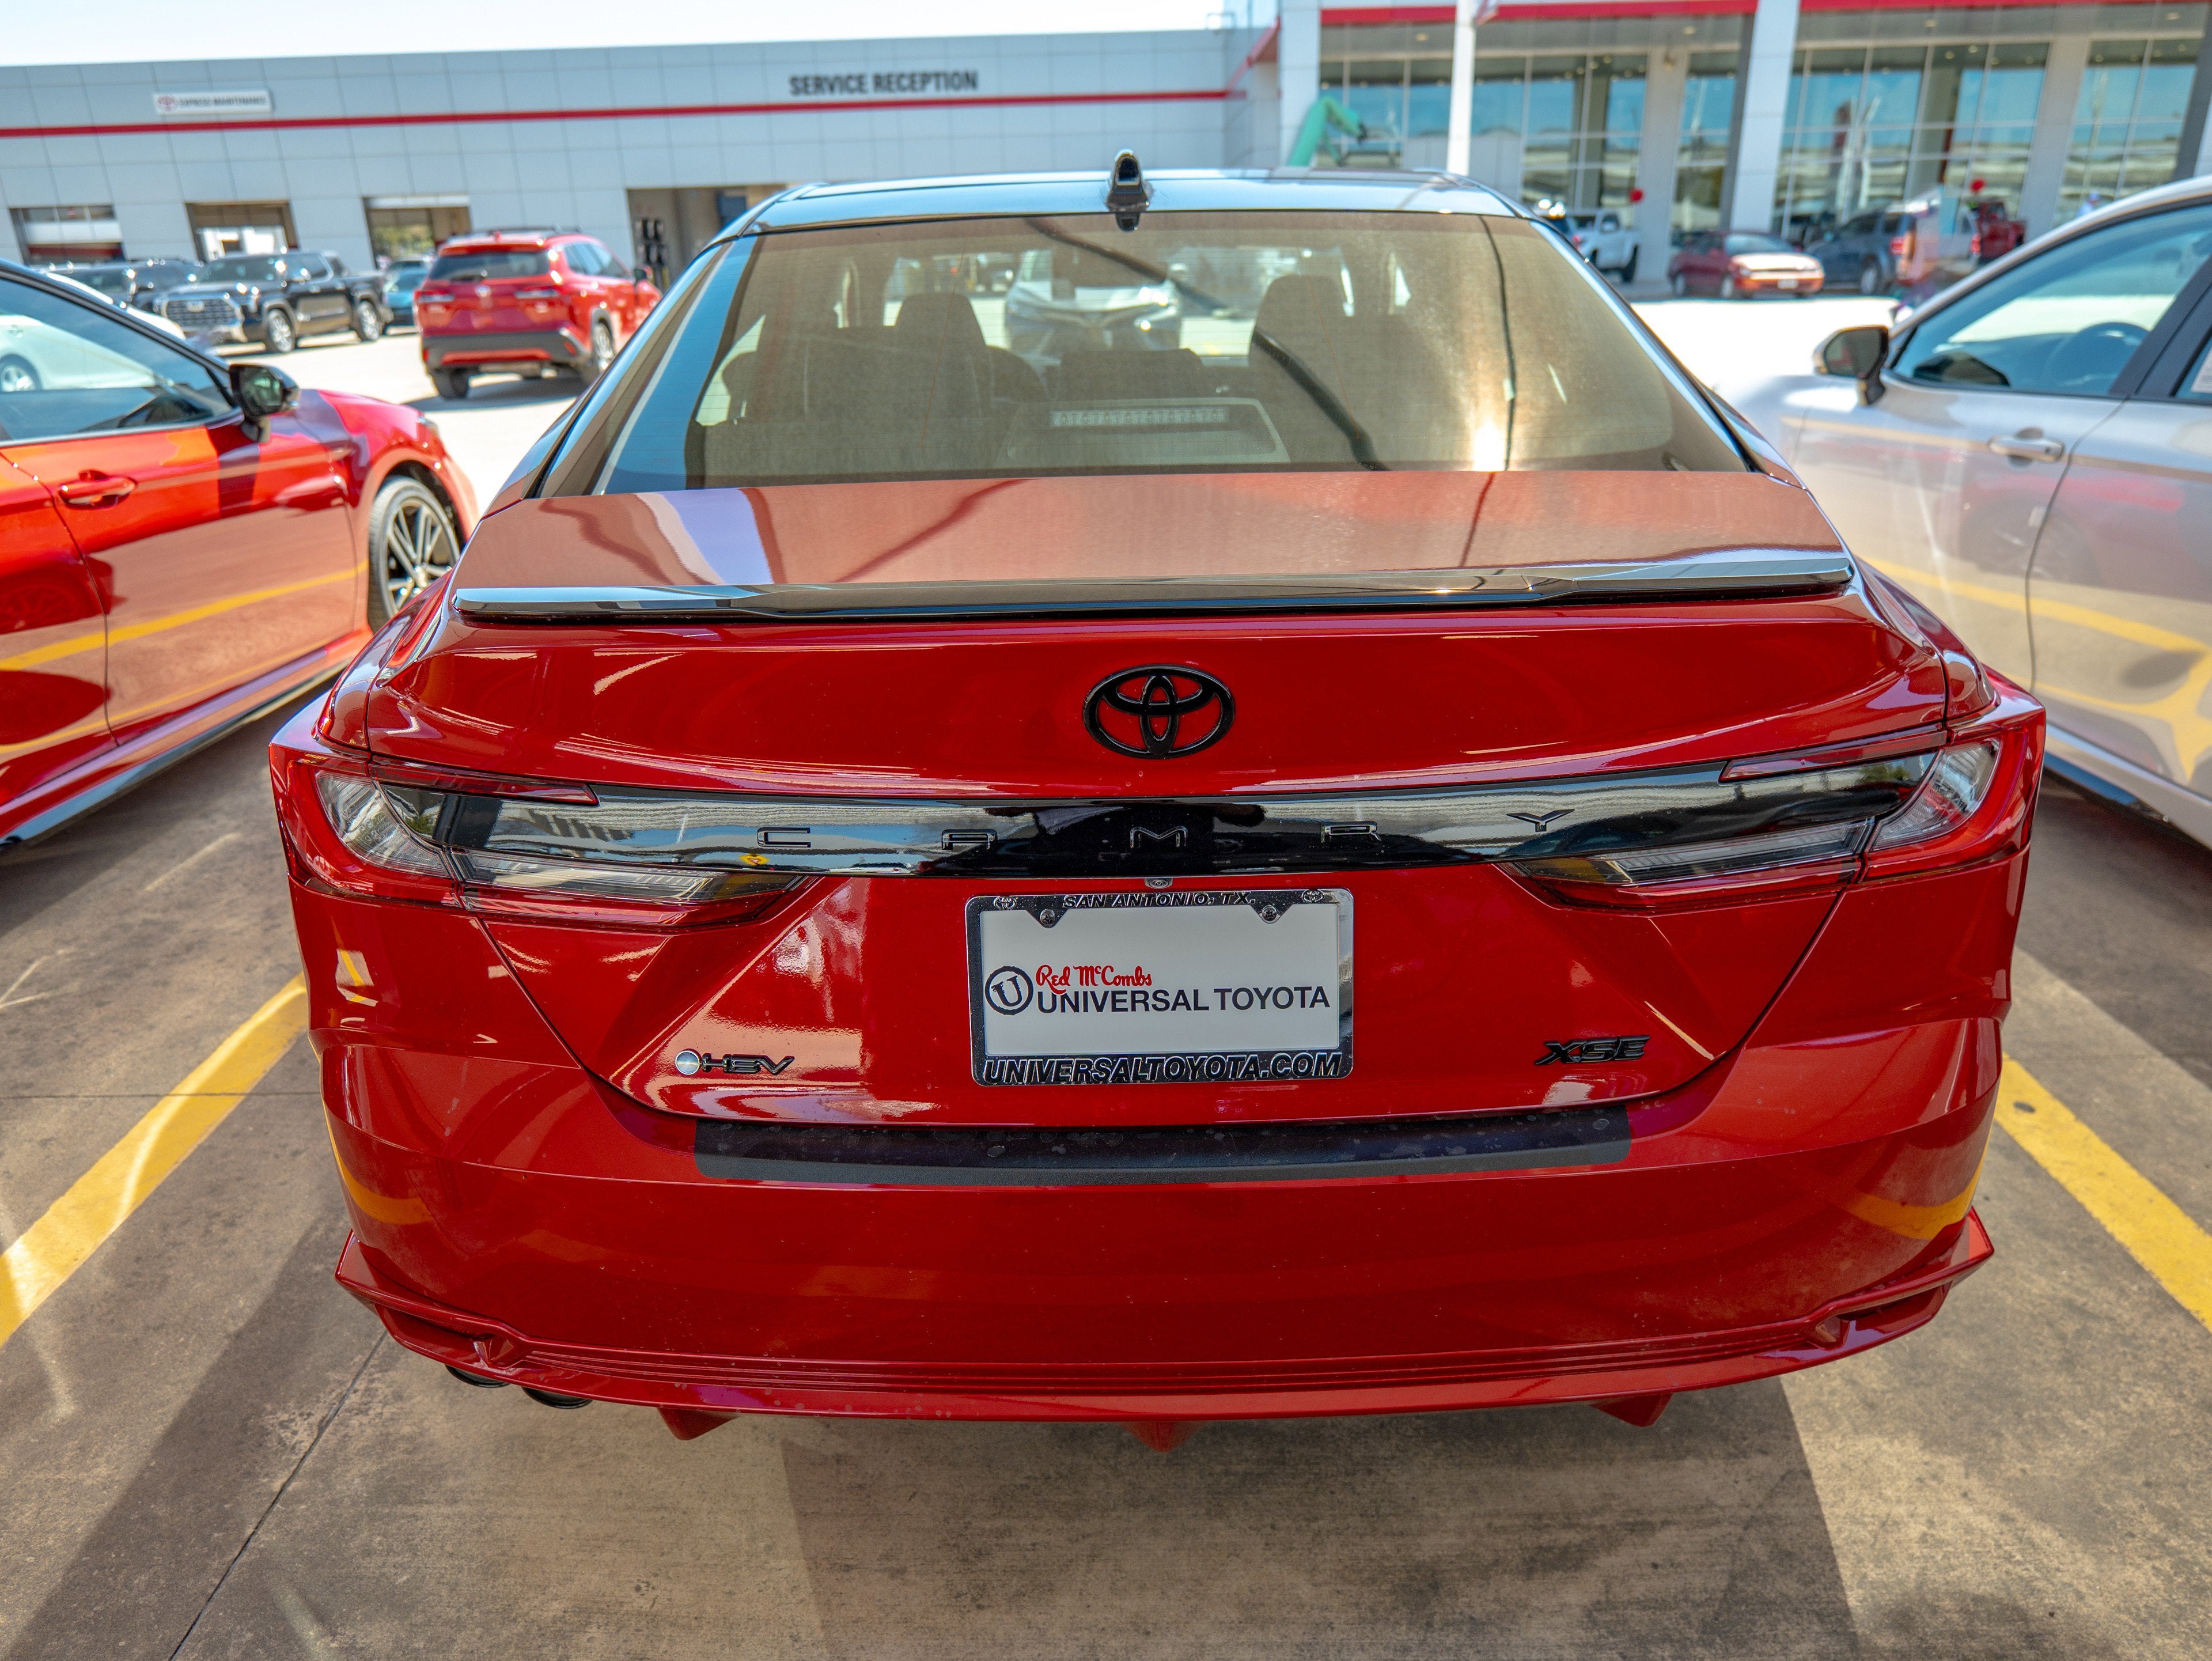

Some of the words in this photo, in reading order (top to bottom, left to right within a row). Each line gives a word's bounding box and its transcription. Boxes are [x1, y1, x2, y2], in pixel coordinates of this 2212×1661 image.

[789, 74, 867, 96] SERVICE
[873, 70, 978, 94] RECEPTION
[756, 808, 1575, 850] CAMRY
[1063, 894, 1107, 909] SAN
[1111, 892, 1214, 908] ANTONIO,
[1036, 964, 1071, 995] Red
[1073, 964, 1153, 987] McCombs
[1037, 989, 1210, 1013] UNIVERSAL
[1213, 985, 1331, 1011] TOYOTA
[1535, 1035, 1650, 1065] XSE
[982, 1052, 1343, 1083] UNIVERSALTOYOTA.COM
